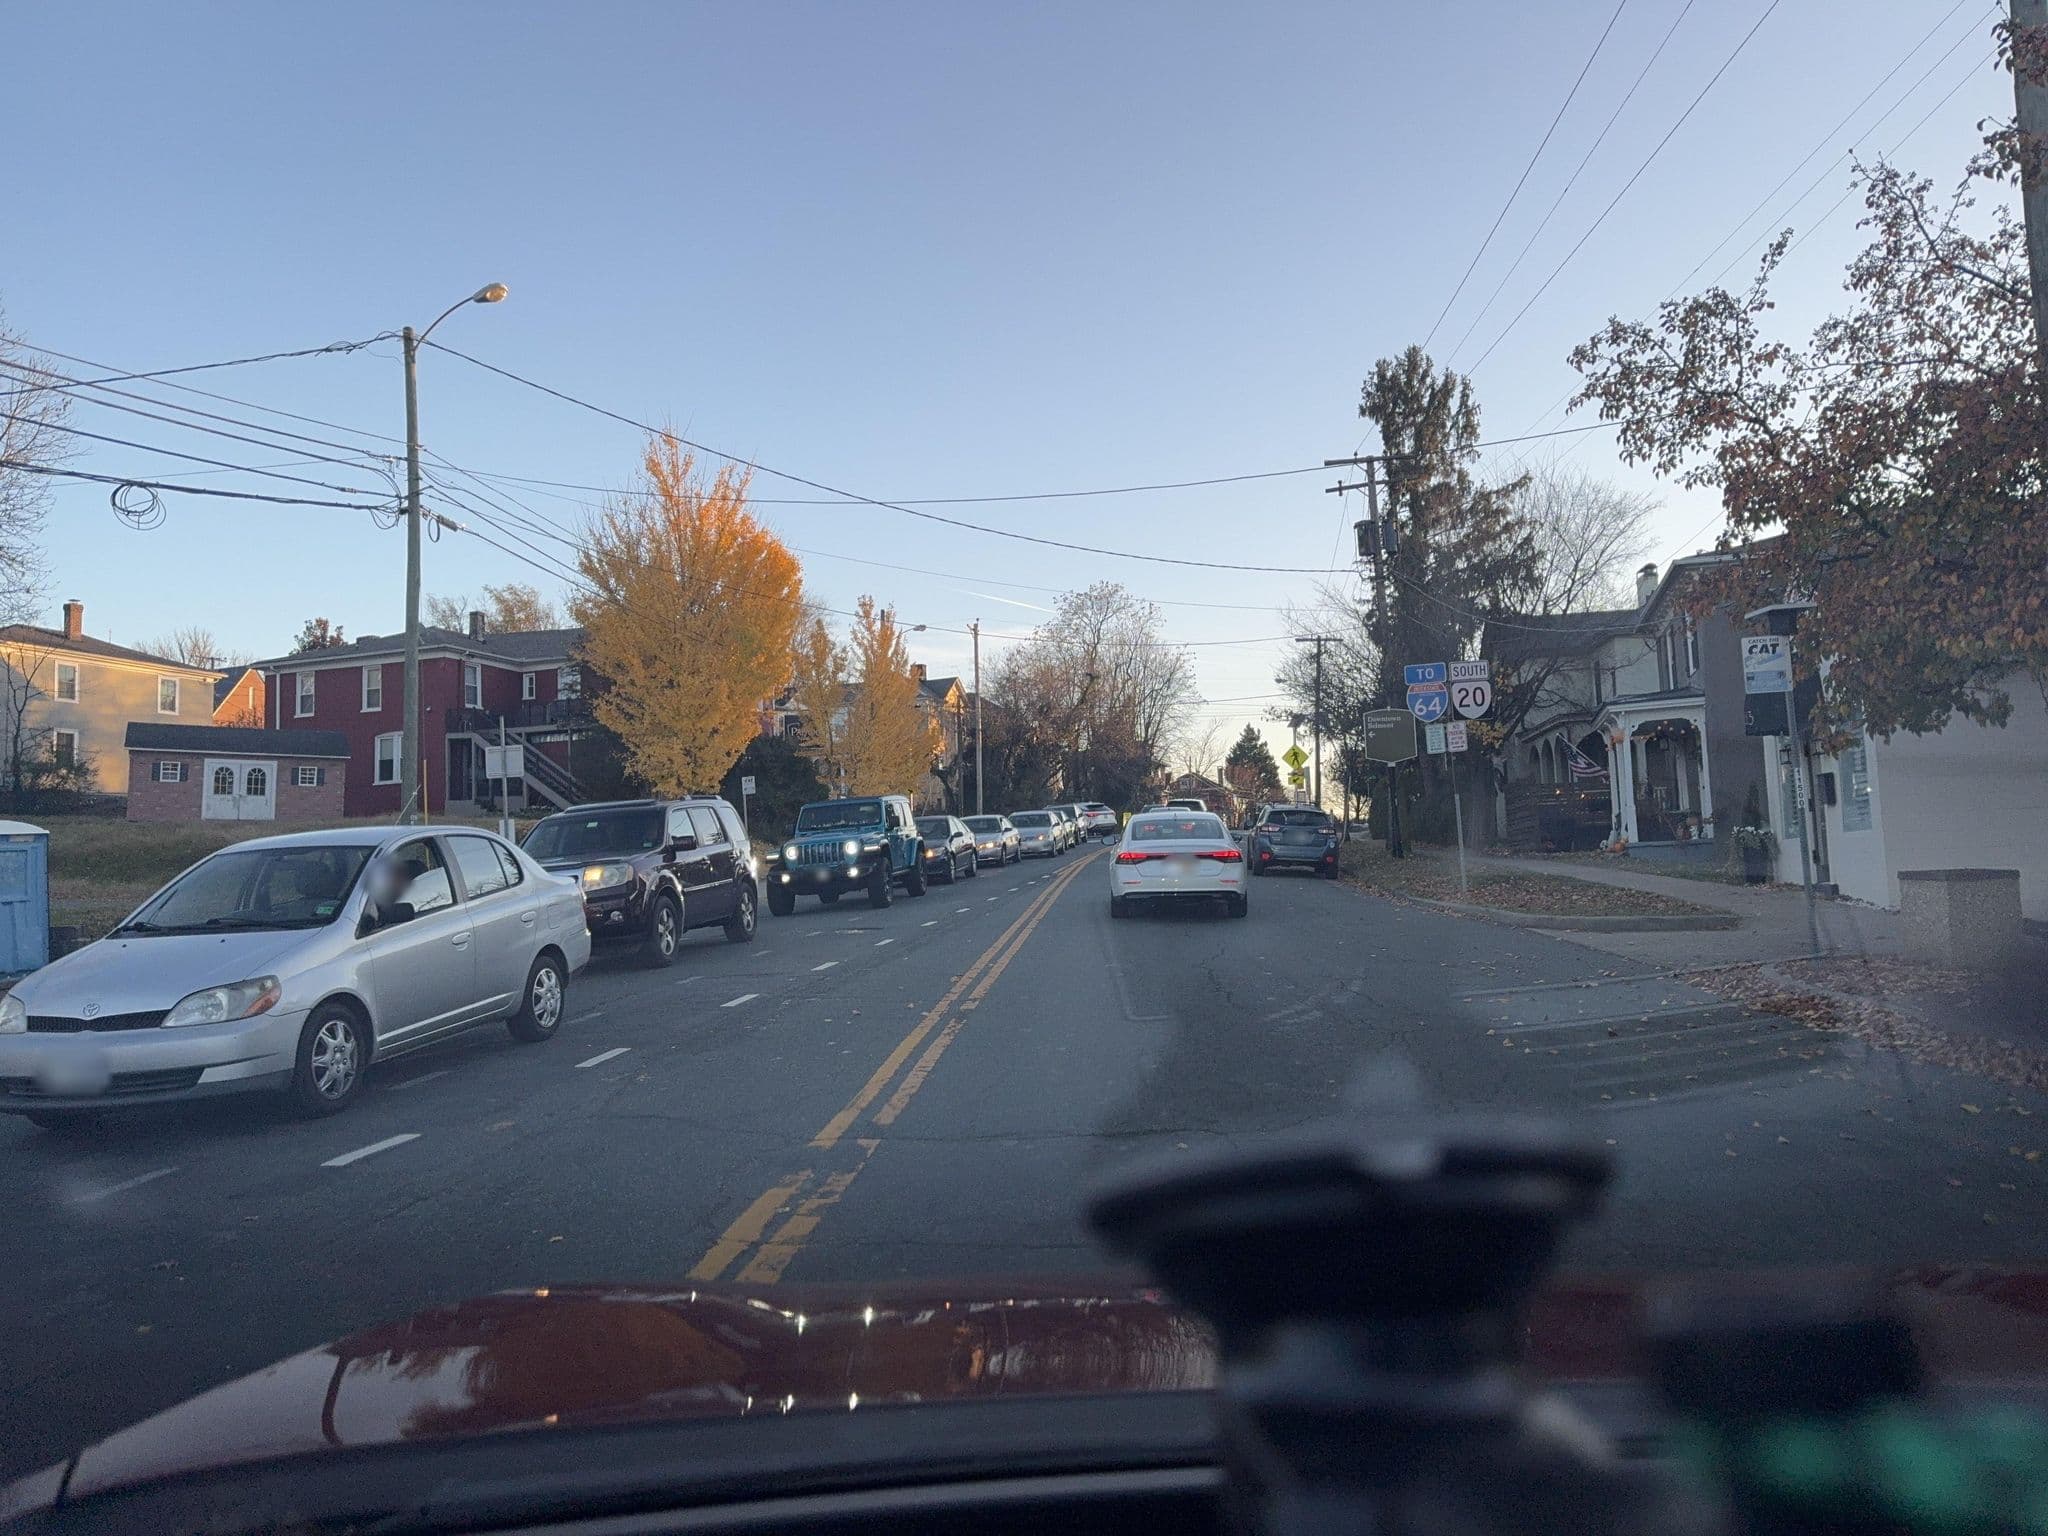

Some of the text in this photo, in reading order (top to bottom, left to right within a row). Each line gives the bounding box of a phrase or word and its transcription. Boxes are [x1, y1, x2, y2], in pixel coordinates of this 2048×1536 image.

[1748, 643, 1779, 655] CAT
[1416, 667, 1434, 680] TO
[1453, 665, 1486, 677] SOUTH
[1458, 687, 1485, 708] 20
[1415, 697, 1441, 716] 64
